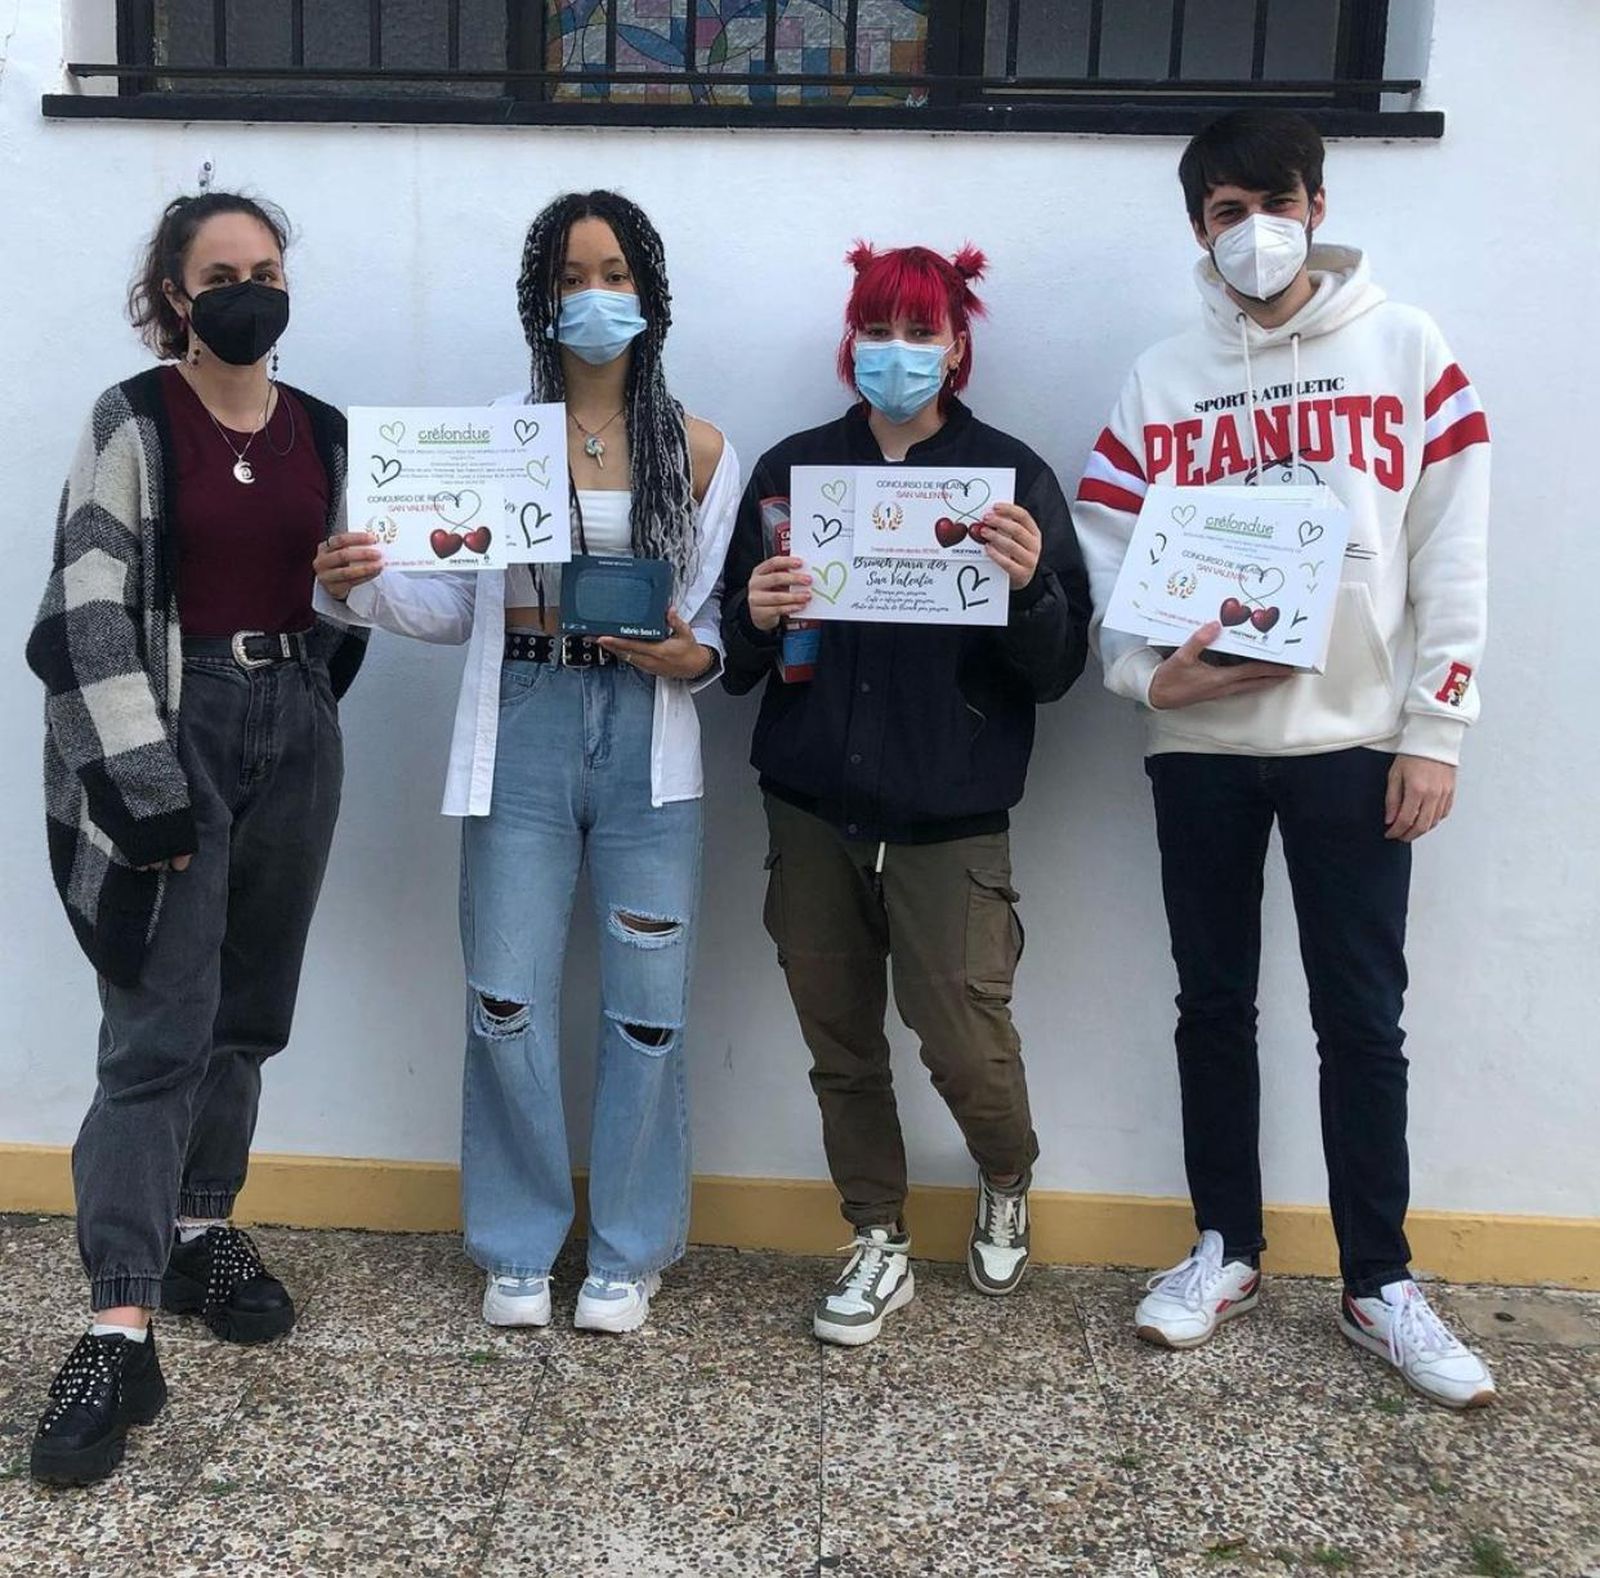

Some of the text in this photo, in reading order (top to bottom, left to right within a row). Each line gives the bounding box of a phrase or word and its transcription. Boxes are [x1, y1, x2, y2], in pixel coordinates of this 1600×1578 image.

[1260, 377, 1344, 402] ATHLETIC
[1143, 394, 1405, 493] PEANUTS
[876, 480, 922, 489] CONCURSO
[923, 481, 934, 489] DE
[367, 495, 414, 503] CONCURSO
[896, 490, 914, 499] SAN
[389, 504, 406, 512] SAN
[886, 507, 892, 519] 1
[378, 521, 387, 532] 3
[893, 559, 924, 574] para
[1196, 563, 1213, 574] SAN
[866, 571, 888, 586] San
[1179, 576, 1188, 587] 2
